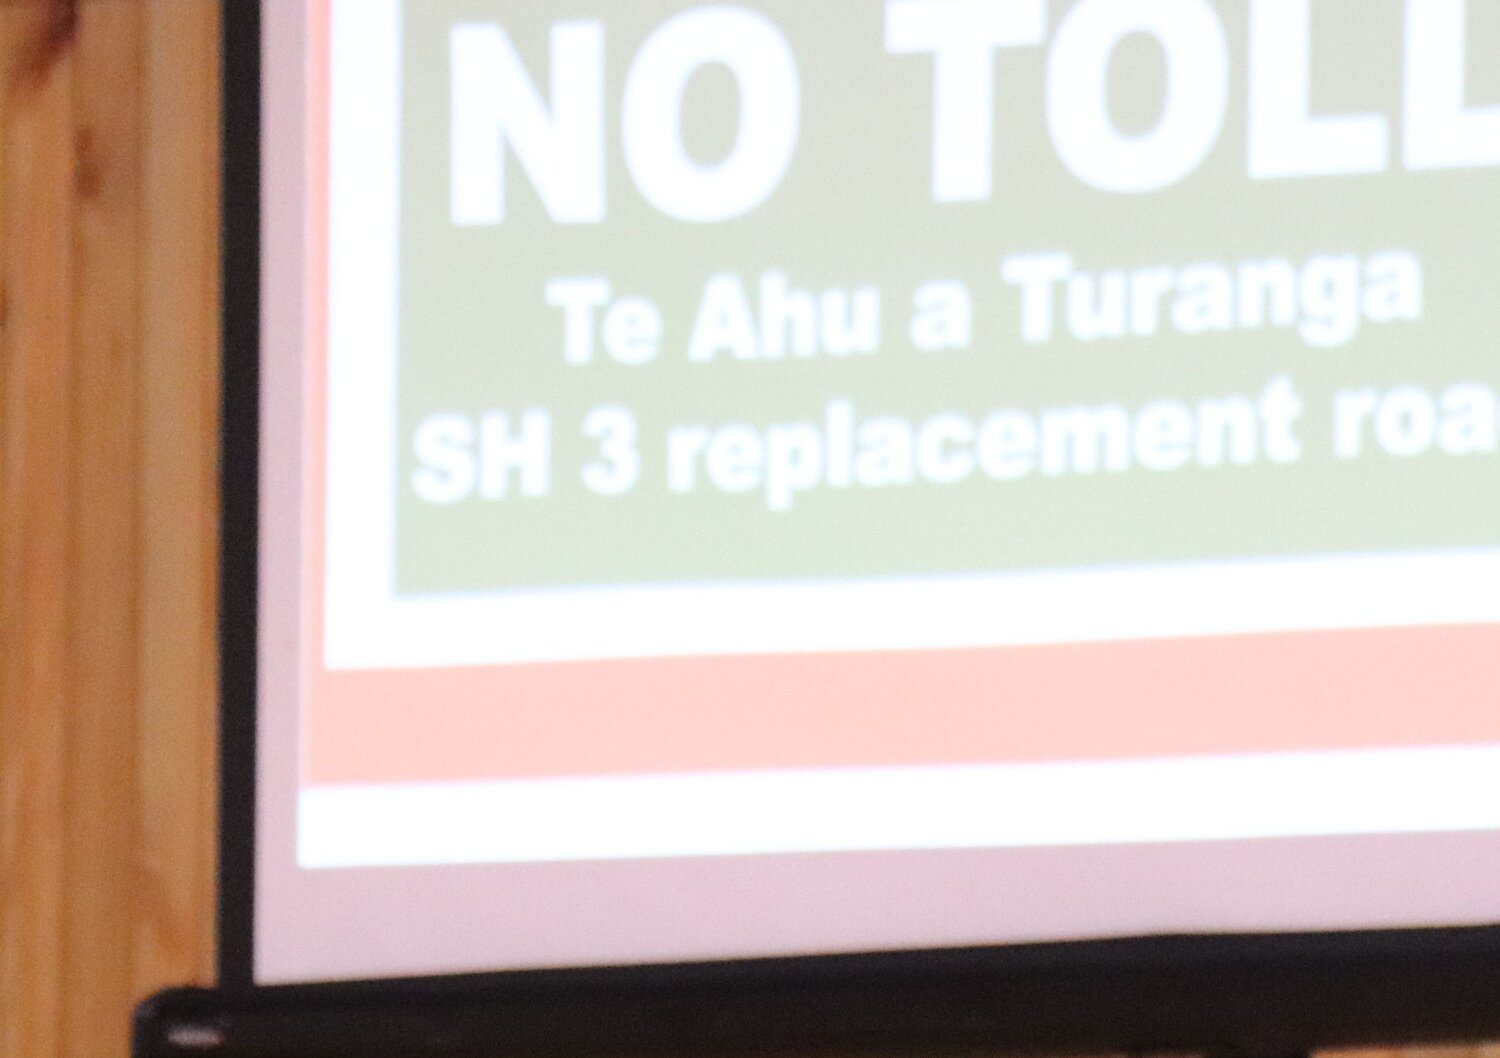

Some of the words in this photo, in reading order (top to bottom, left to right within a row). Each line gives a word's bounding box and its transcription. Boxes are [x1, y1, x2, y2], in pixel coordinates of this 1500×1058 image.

[450, 5, 800, 226] NO
[546, 277, 662, 365] Te
[687, 270, 881, 362] Ahu
[908, 280, 973, 352] a
[1001, 250, 1423, 347] Turanga
[411, 409, 552, 505] SH
[581, 405, 641, 496] 3
[667, 374, 1304, 512] replacement
